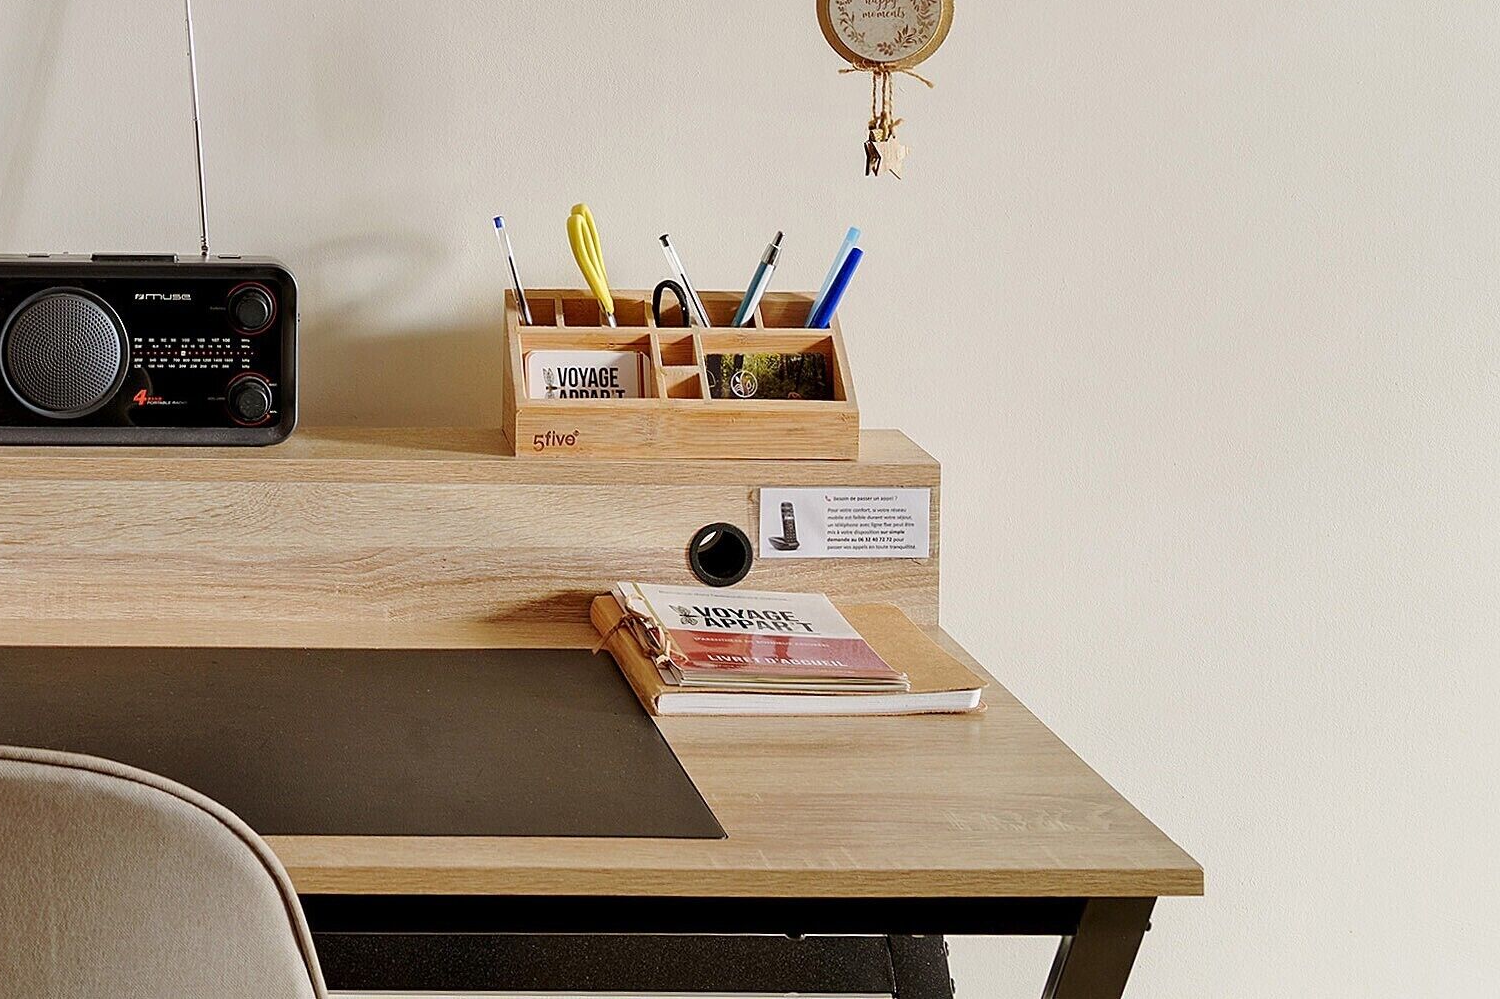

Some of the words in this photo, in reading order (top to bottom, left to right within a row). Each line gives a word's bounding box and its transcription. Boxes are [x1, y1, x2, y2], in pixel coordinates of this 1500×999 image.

[862, 9, 906, 19] moments
[145, 293, 192, 301] muse
[557, 367, 619, 388] VOYAGE
[133, 389, 148, 406] 4
[693, 606, 799, 621] VOYAGE
[705, 618, 814, 632] APPAR'T
[708, 654, 759, 663] LIVRET
[766, 657, 849, 667] D'ACCUEIL
